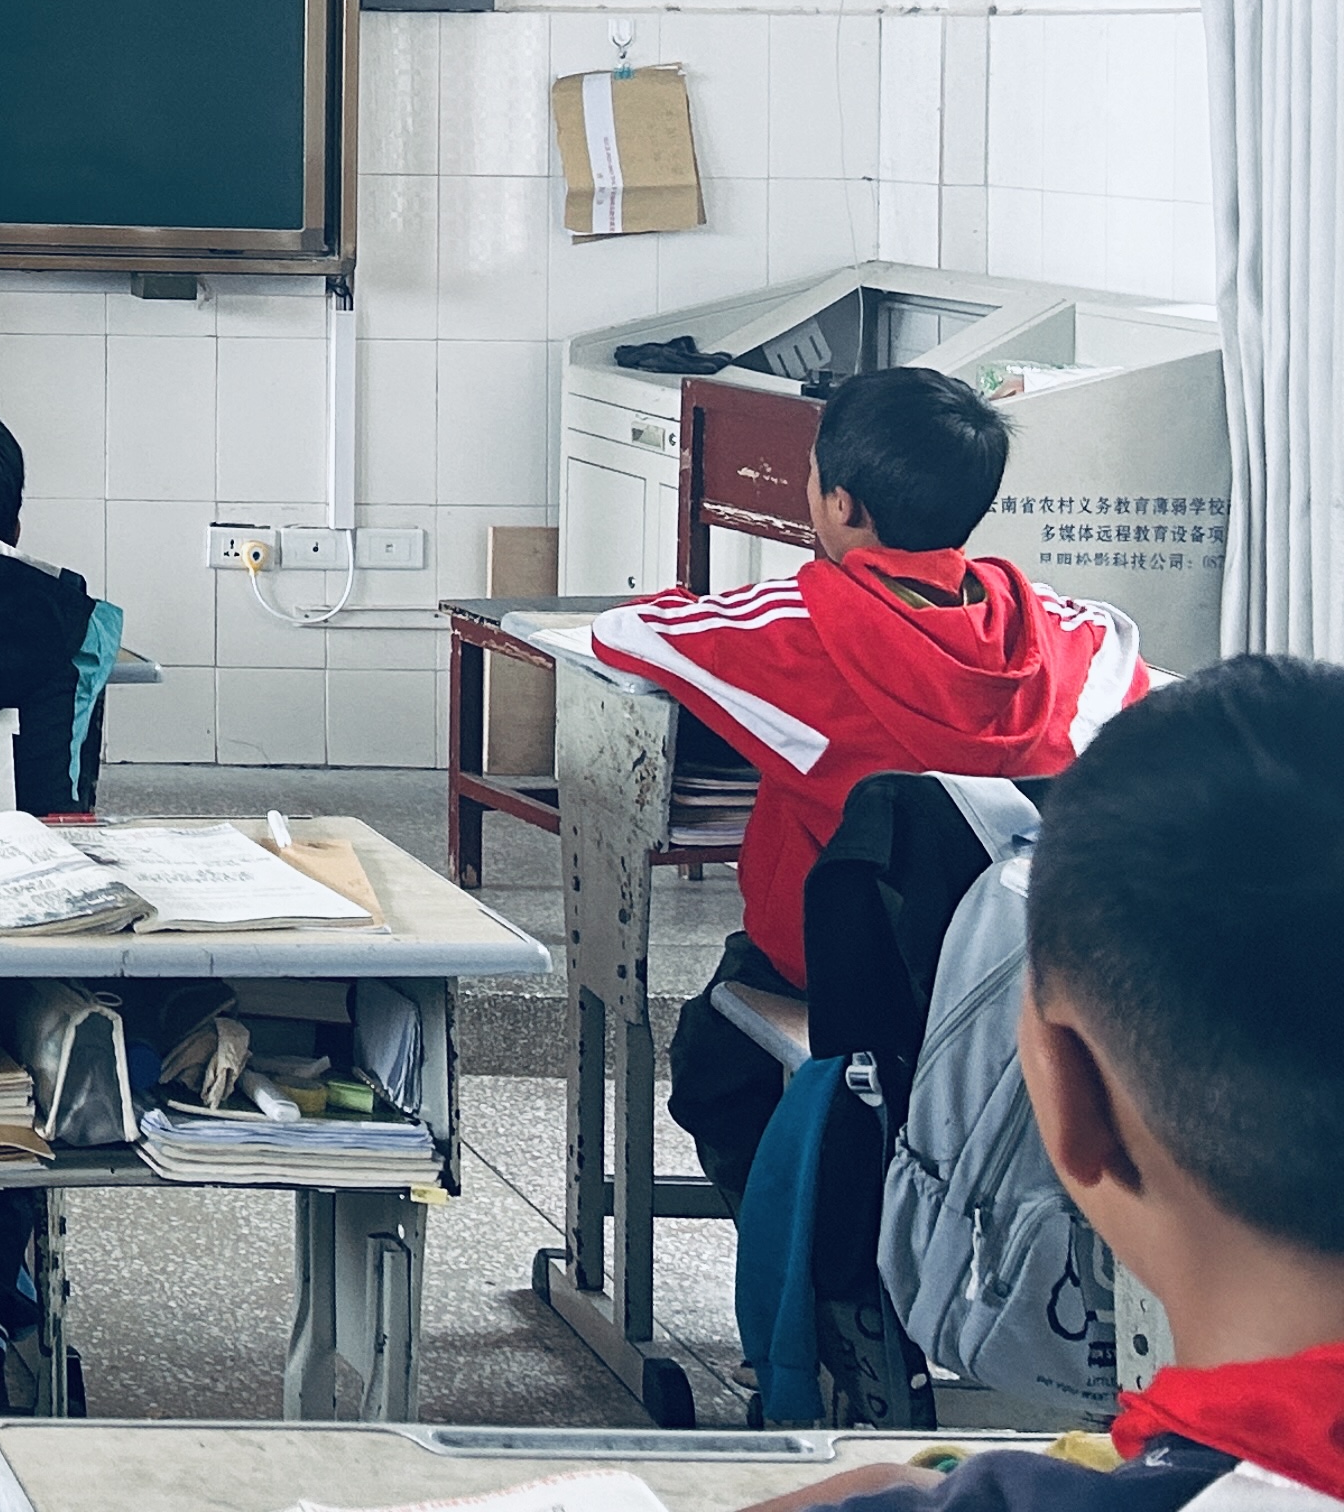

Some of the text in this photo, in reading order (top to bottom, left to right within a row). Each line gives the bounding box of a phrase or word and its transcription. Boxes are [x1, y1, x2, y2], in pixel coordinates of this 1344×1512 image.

[987, 495, 1231, 516] 云南省农村义务教育薄弱学校
[1041, 524, 1225, 543] 多媒体远程教育设备项
